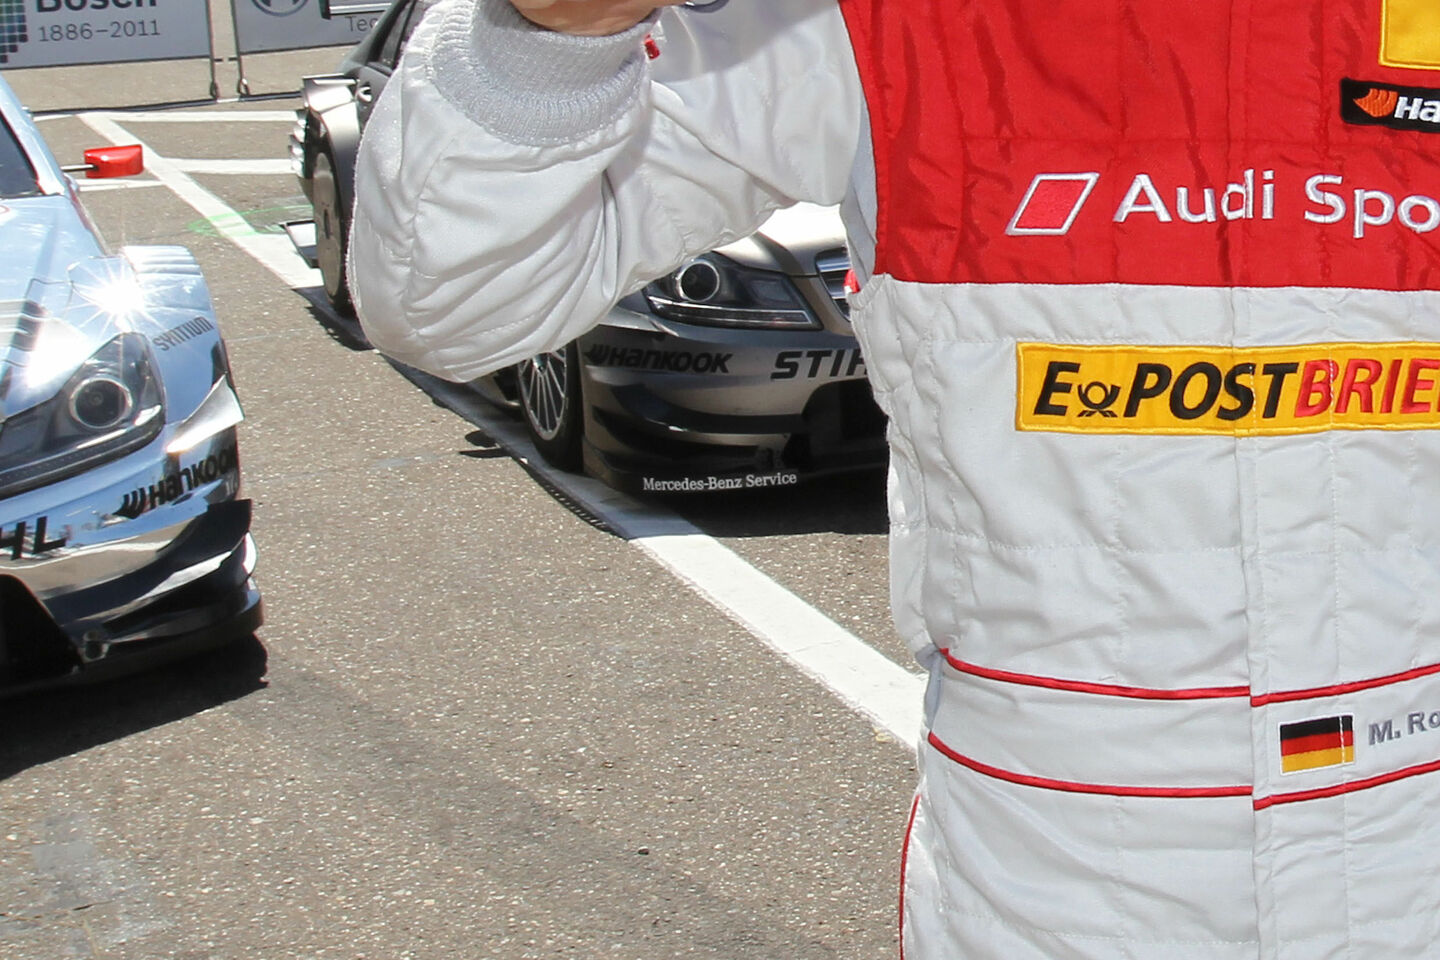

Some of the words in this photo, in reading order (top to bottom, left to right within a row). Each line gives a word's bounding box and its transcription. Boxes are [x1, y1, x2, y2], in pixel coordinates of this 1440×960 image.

[1114, 169, 1275, 224] Audi
[643, 476, 743, 491] Mercedes-Benz
[746, 472, 797, 489] Service
[1368, 720, 1401, 746] M.
